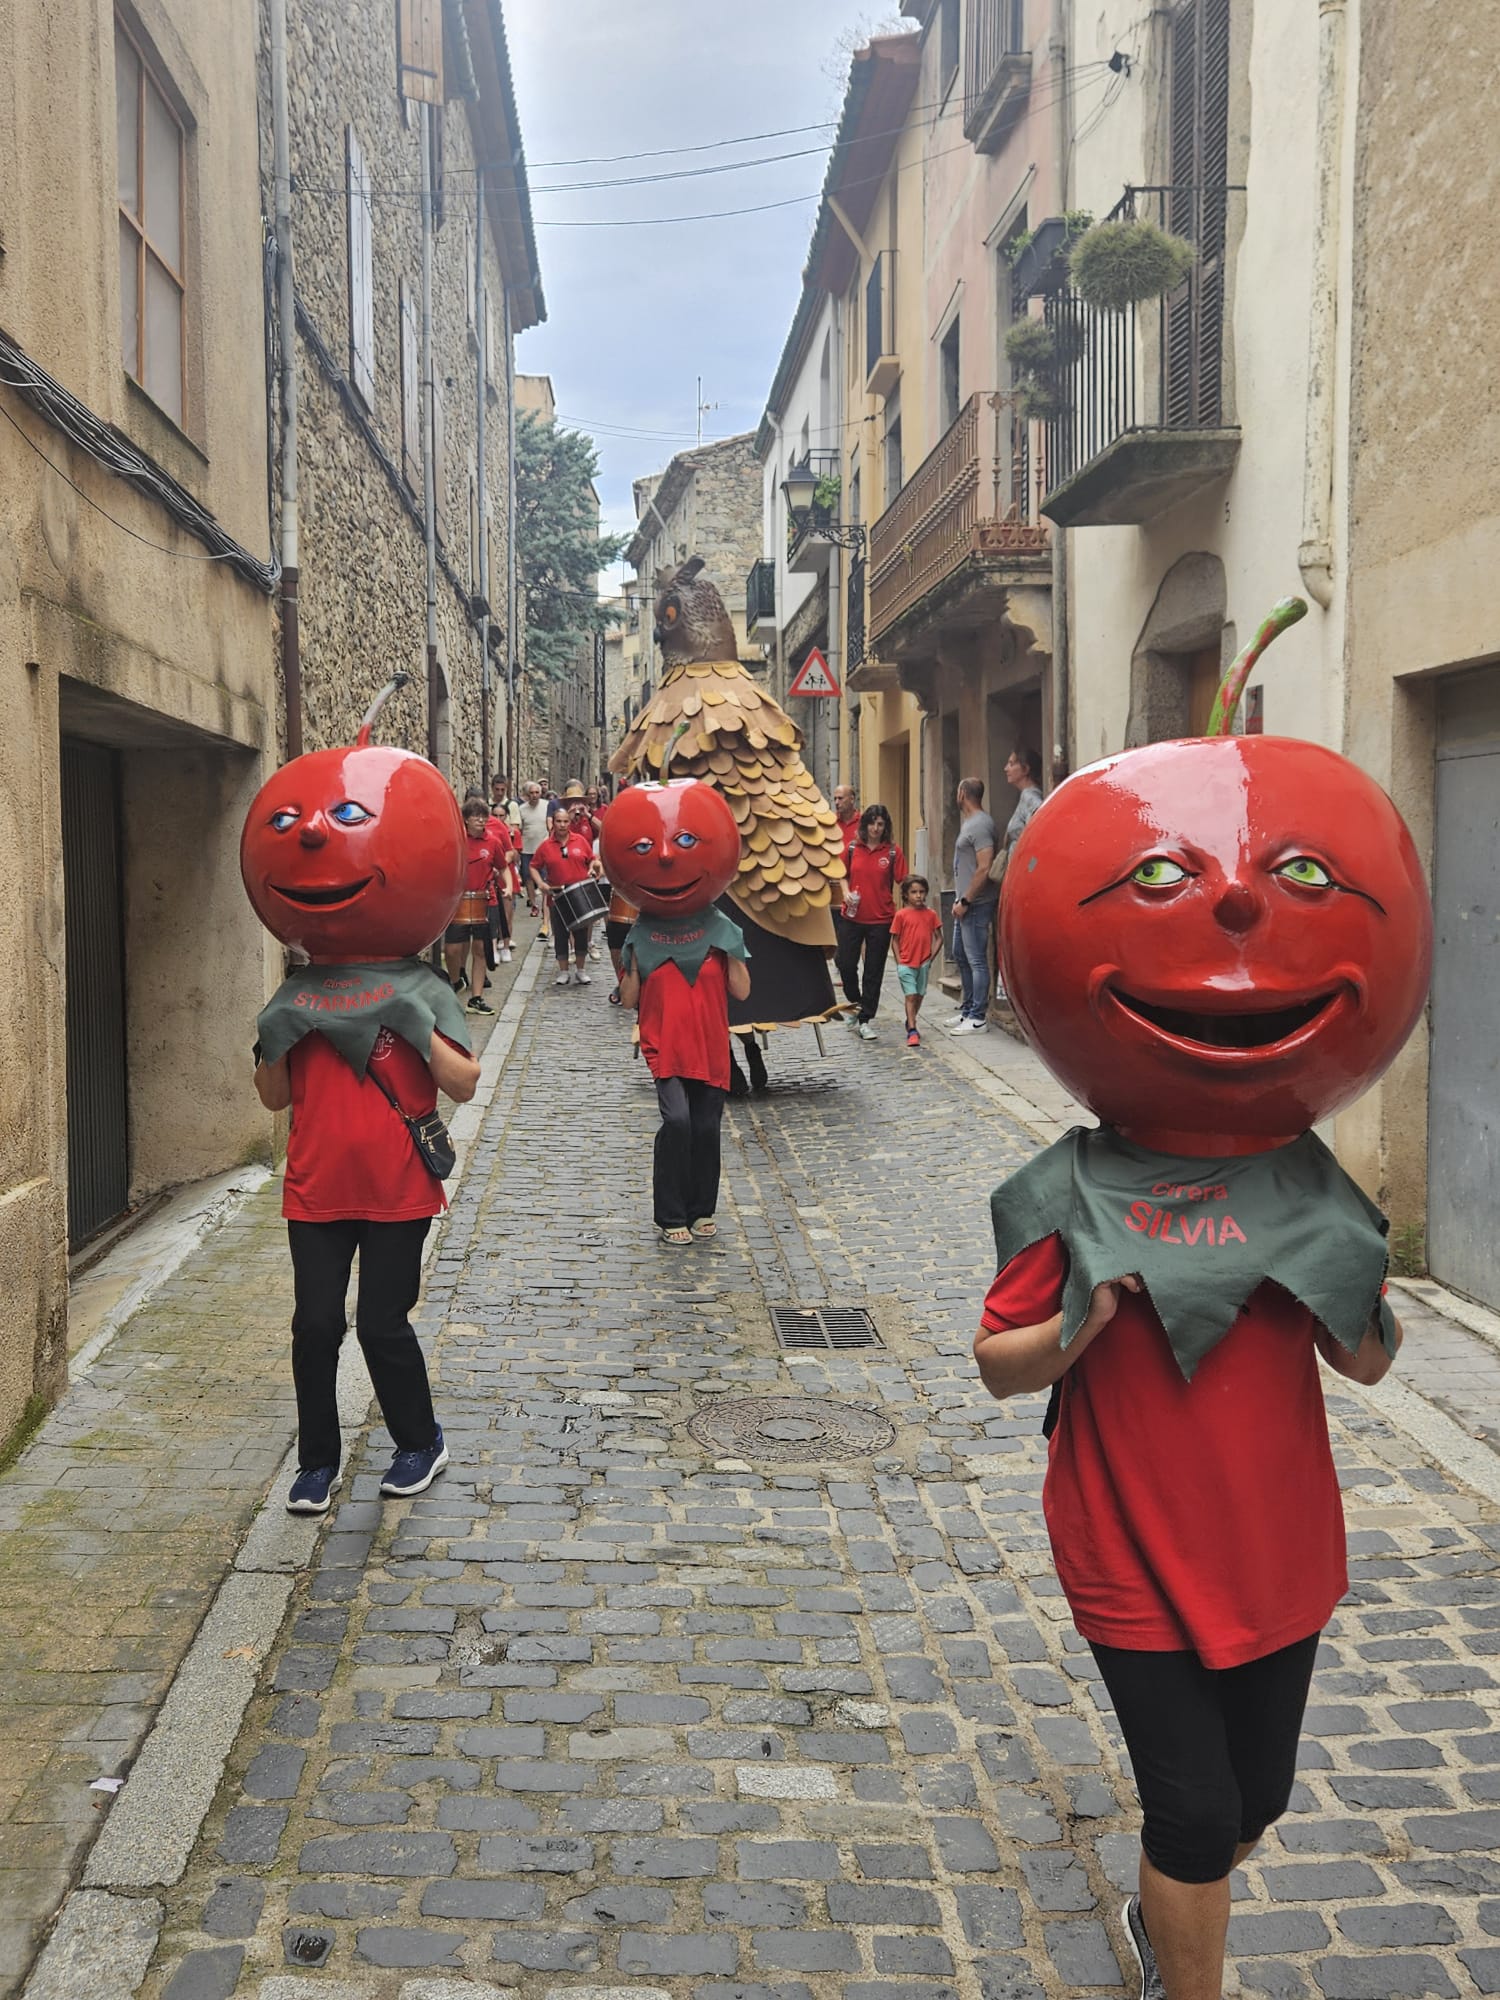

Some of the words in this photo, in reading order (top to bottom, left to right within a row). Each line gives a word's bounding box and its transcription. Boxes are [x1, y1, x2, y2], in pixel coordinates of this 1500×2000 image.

[293, 982, 395, 1012] STARKING
[1151, 1182, 1229, 1202] Cirera
[1124, 1199, 1248, 1247] SILVIA
